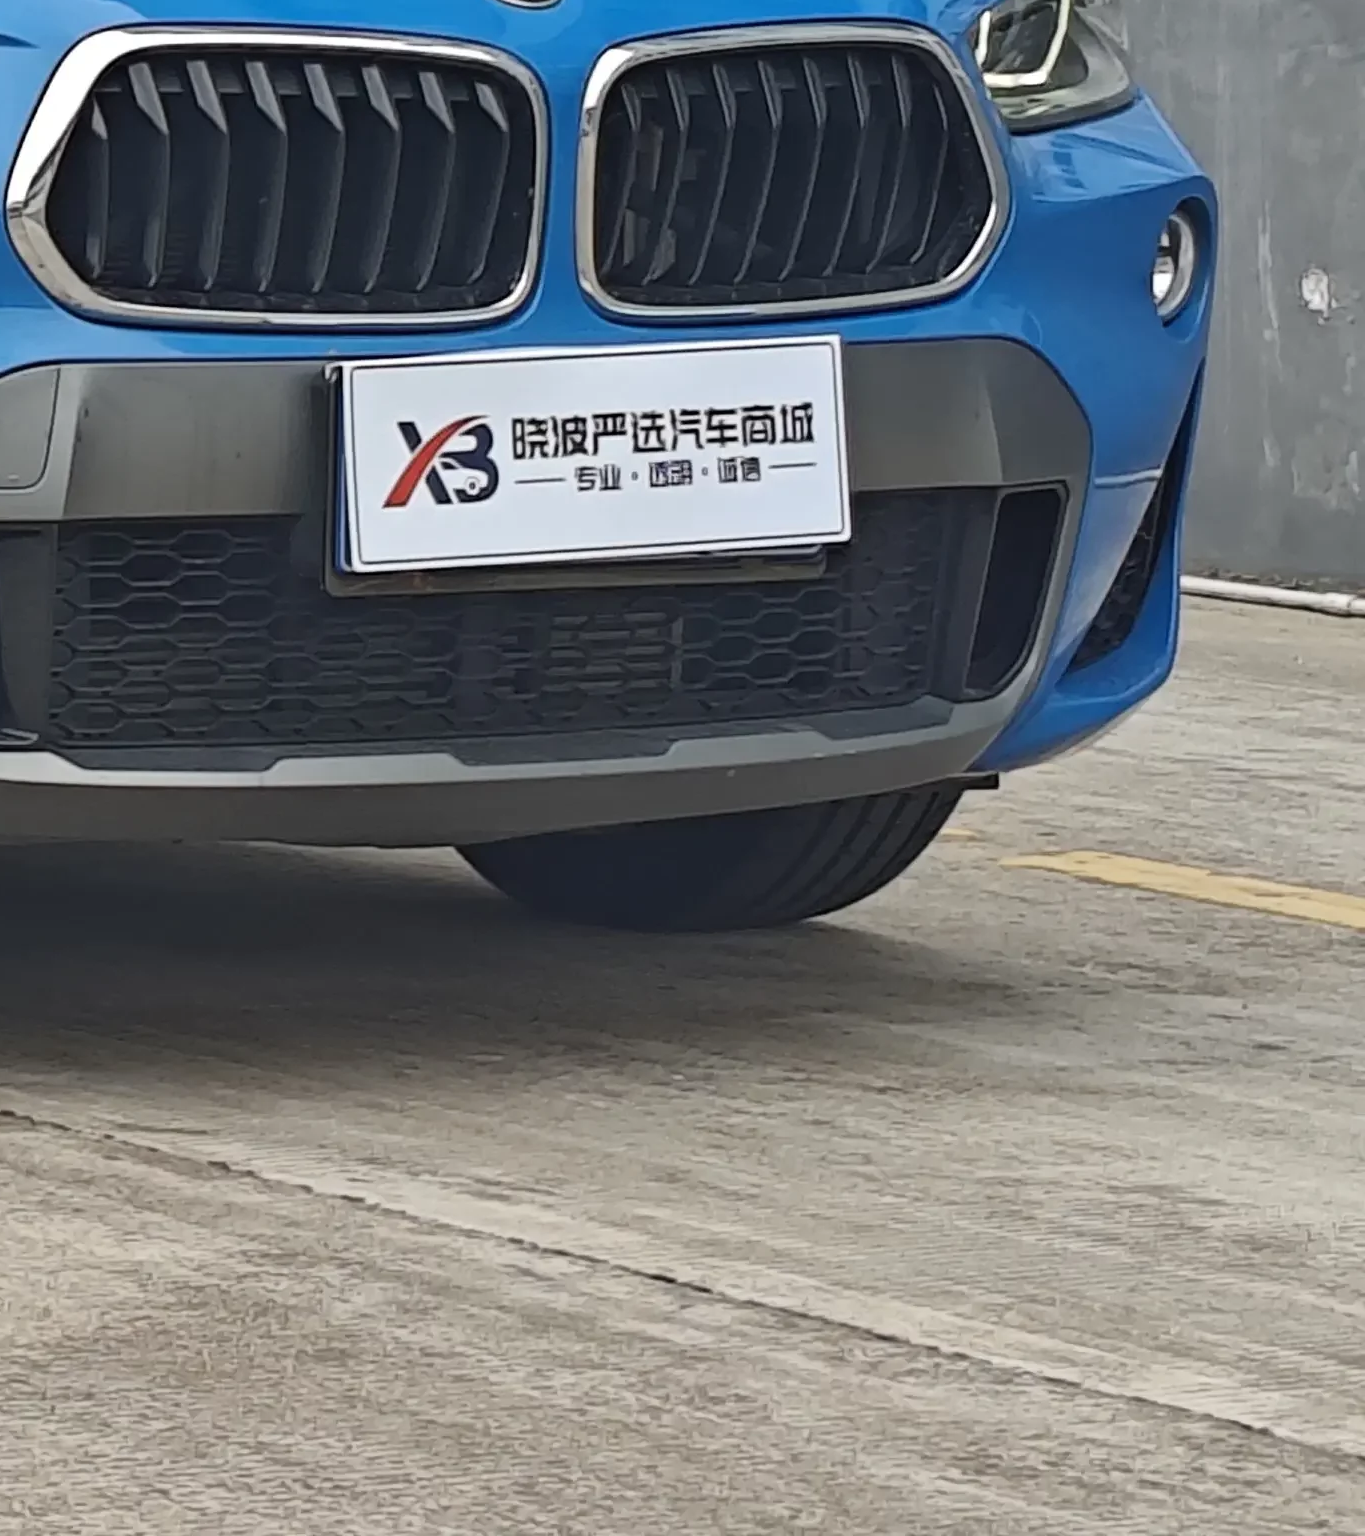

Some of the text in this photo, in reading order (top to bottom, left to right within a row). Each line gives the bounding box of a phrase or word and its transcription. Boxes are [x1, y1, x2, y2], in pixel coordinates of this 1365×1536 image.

[511, 401, 815, 460] 晓波严选汽车商城
